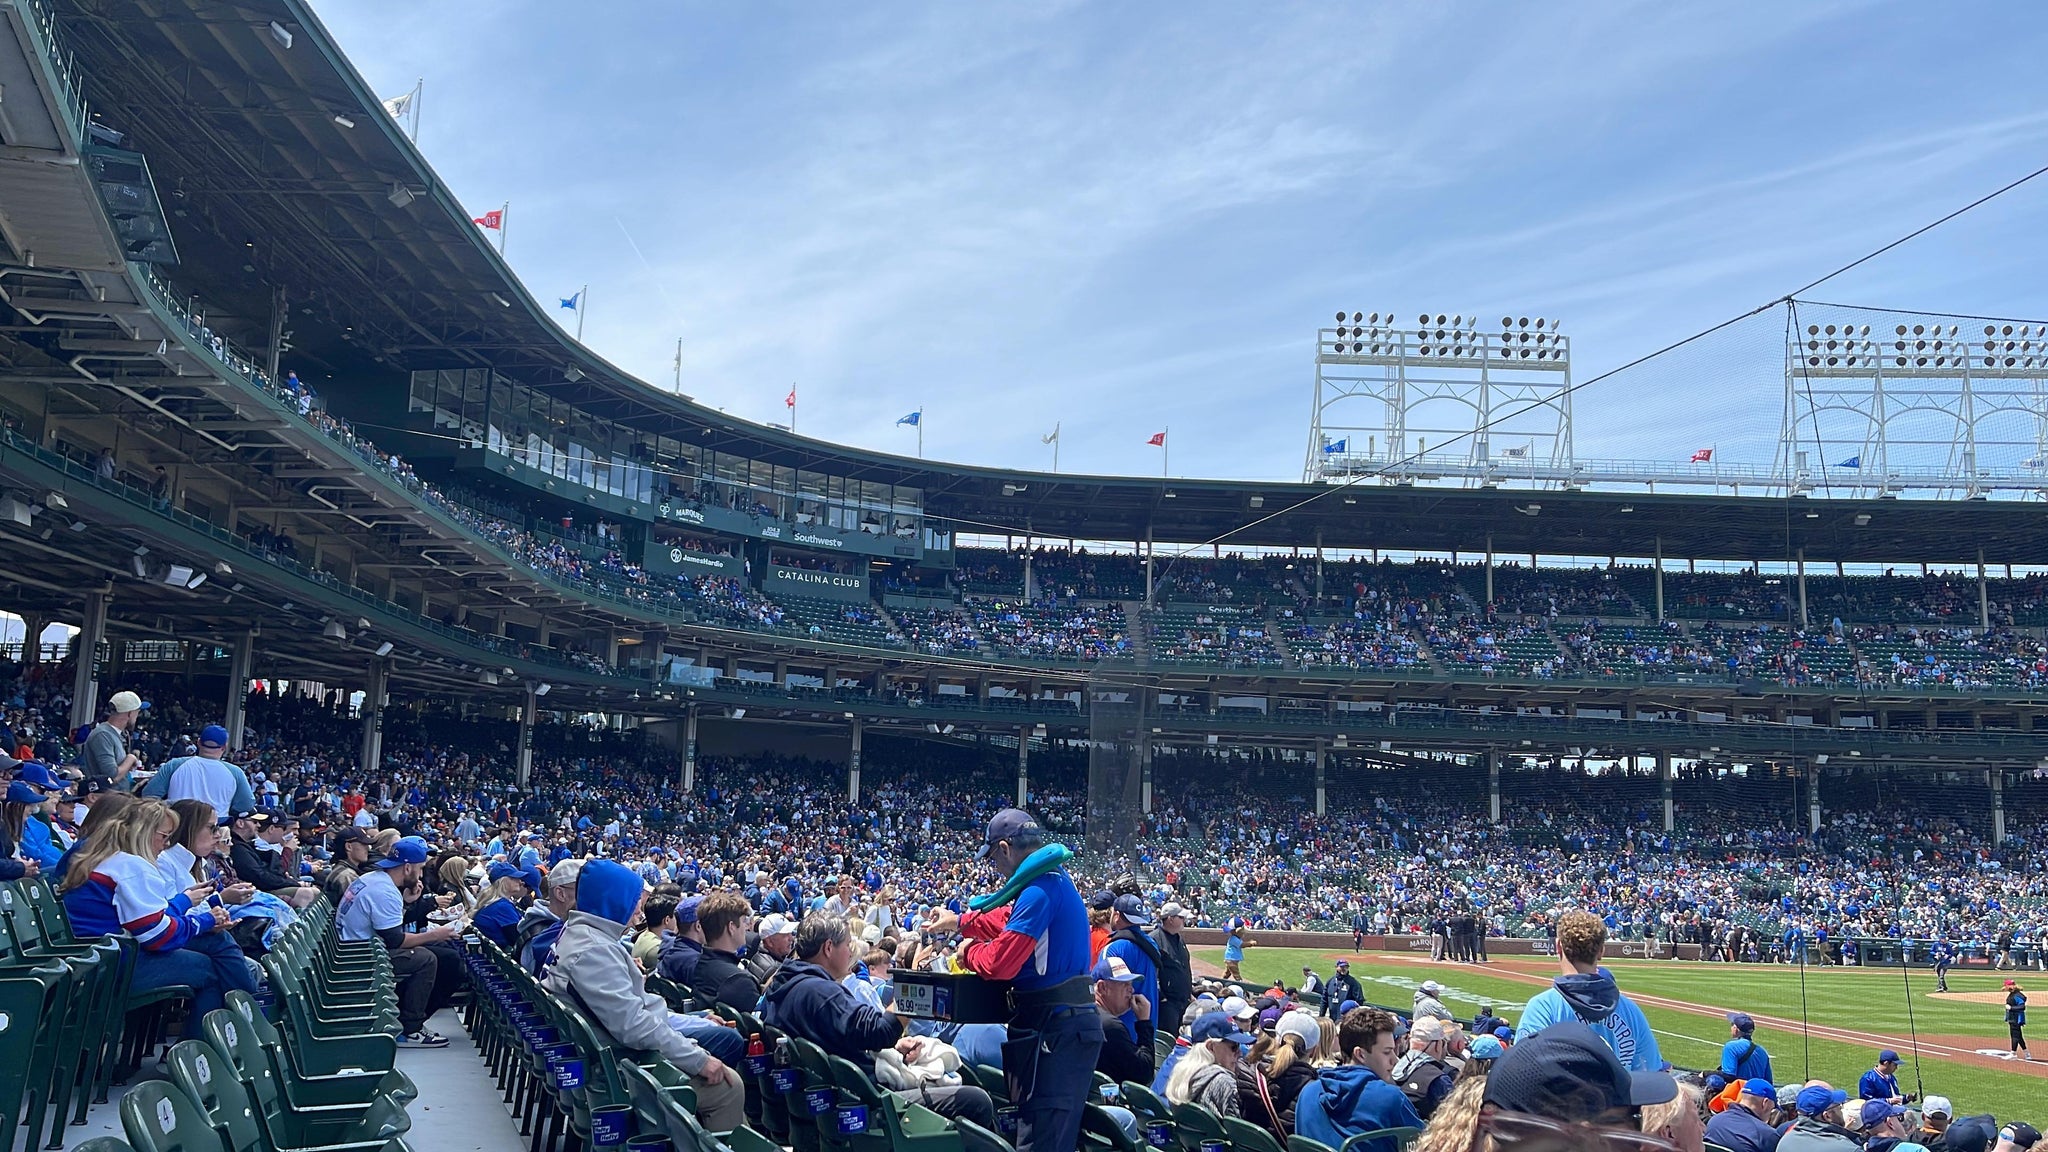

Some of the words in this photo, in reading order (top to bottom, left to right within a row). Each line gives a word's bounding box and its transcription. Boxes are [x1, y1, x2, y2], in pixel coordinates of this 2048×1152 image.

[675, 508, 705, 522] MARQUEE
[794, 533, 837, 547] Southwest
[682, 554, 724, 568] JamesHardie
[777, 570, 829, 585] CATALINA
[833, 577, 860, 588] CLUB
[199, 1060, 207, 1078] 3
[162, 1104, 170, 1125] 4
